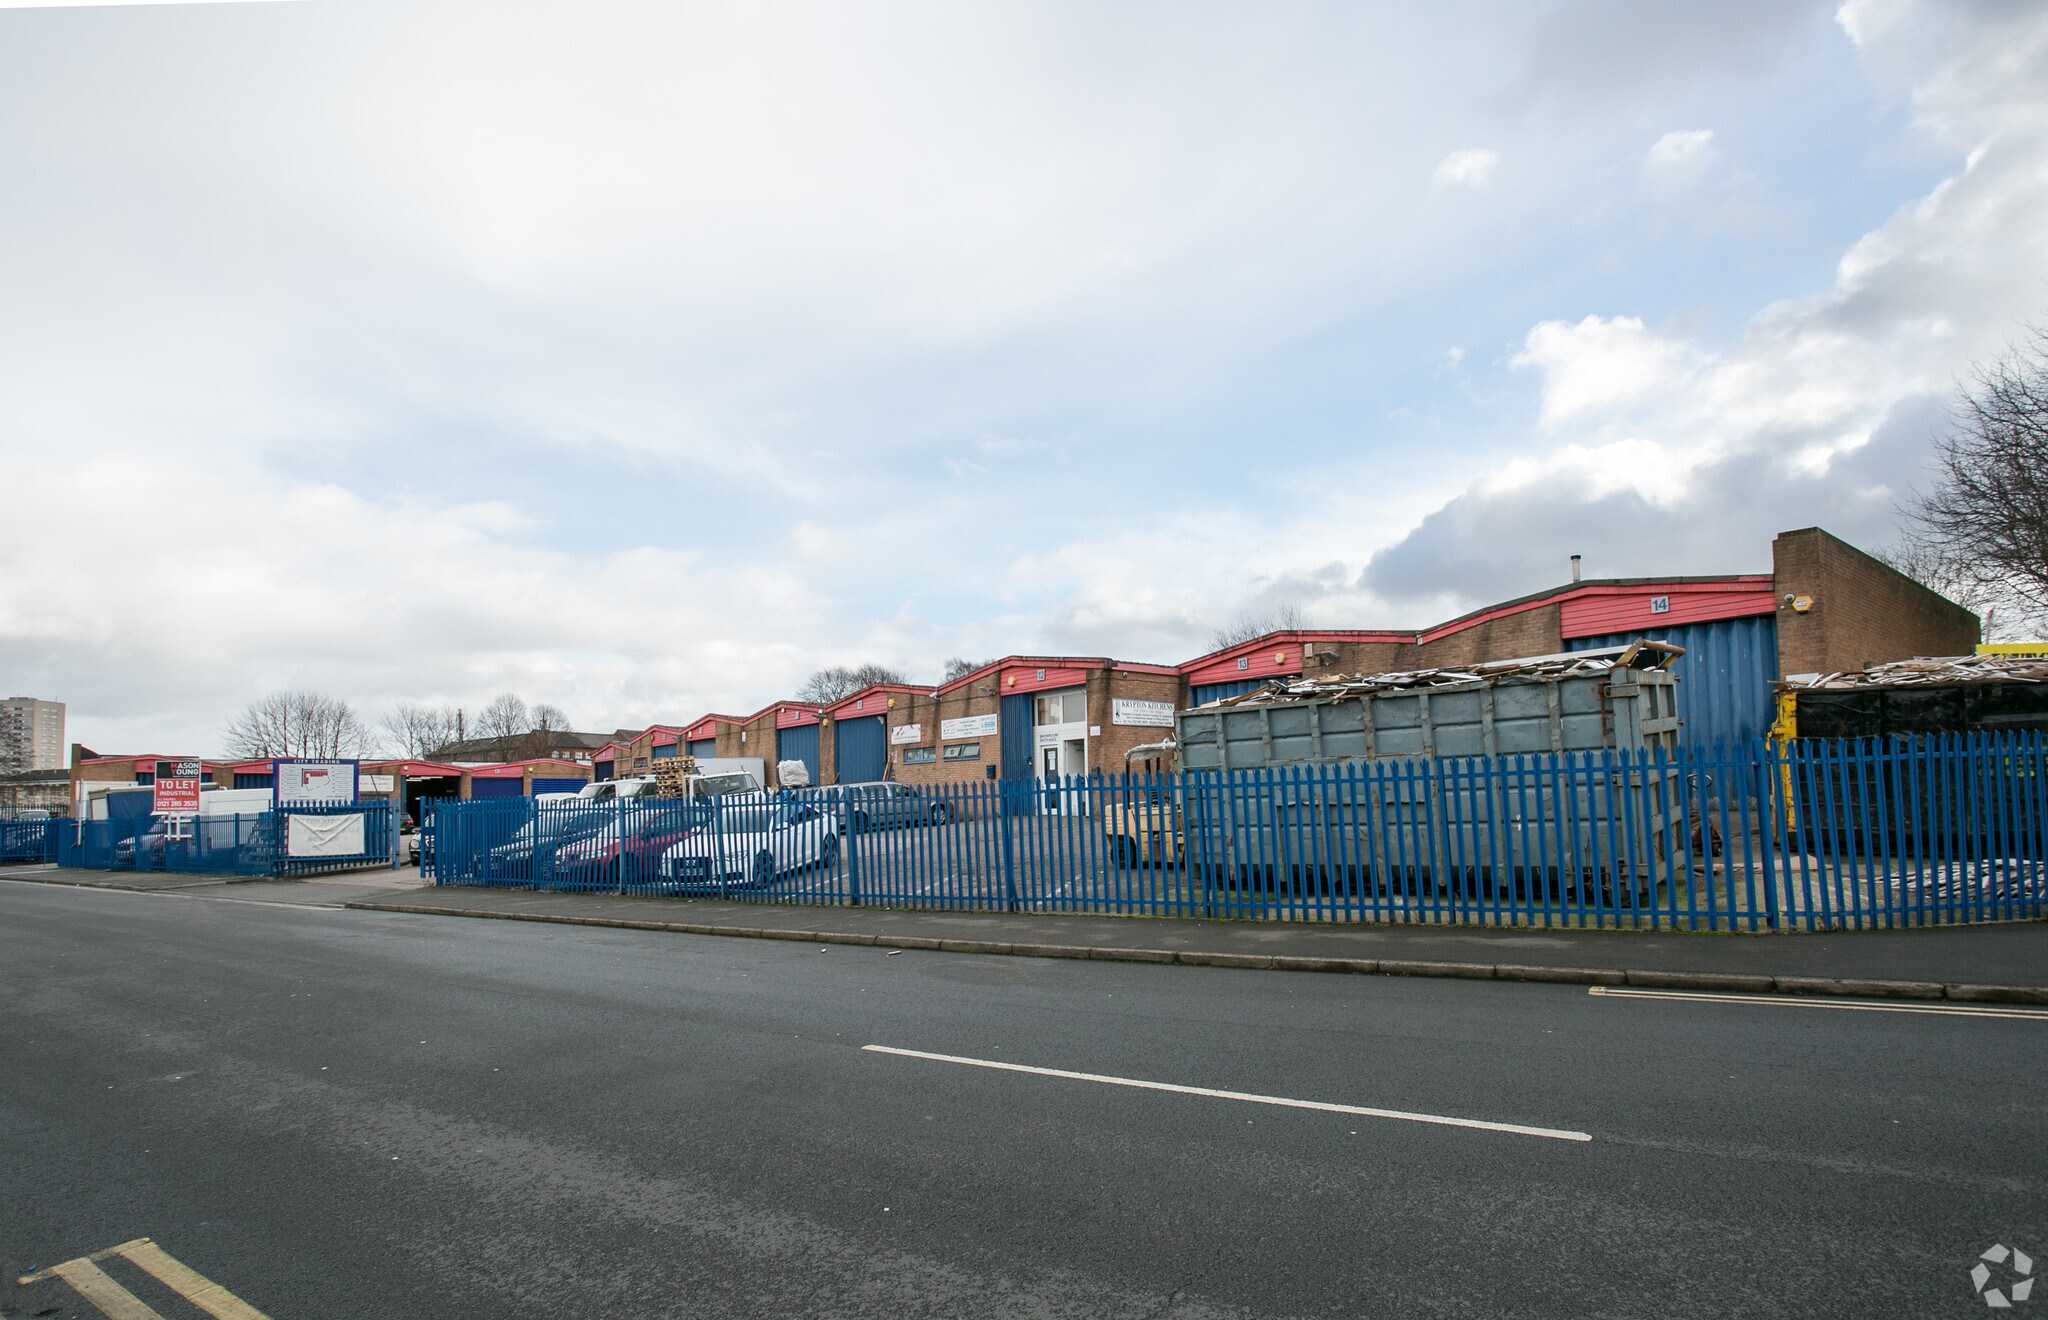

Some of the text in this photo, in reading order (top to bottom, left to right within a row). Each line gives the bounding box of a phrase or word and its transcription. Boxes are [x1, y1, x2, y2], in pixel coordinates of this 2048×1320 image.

[1652, 598, 1668, 612] 14
[1238, 658, 1247, 669] 13
[1038, 670, 1045, 680] 12
[1121, 700, 1174, 711] KRYPTON KITCHENS
[170, 768, 199, 776] YOUNG
[160, 780, 196, 789] TO LET
